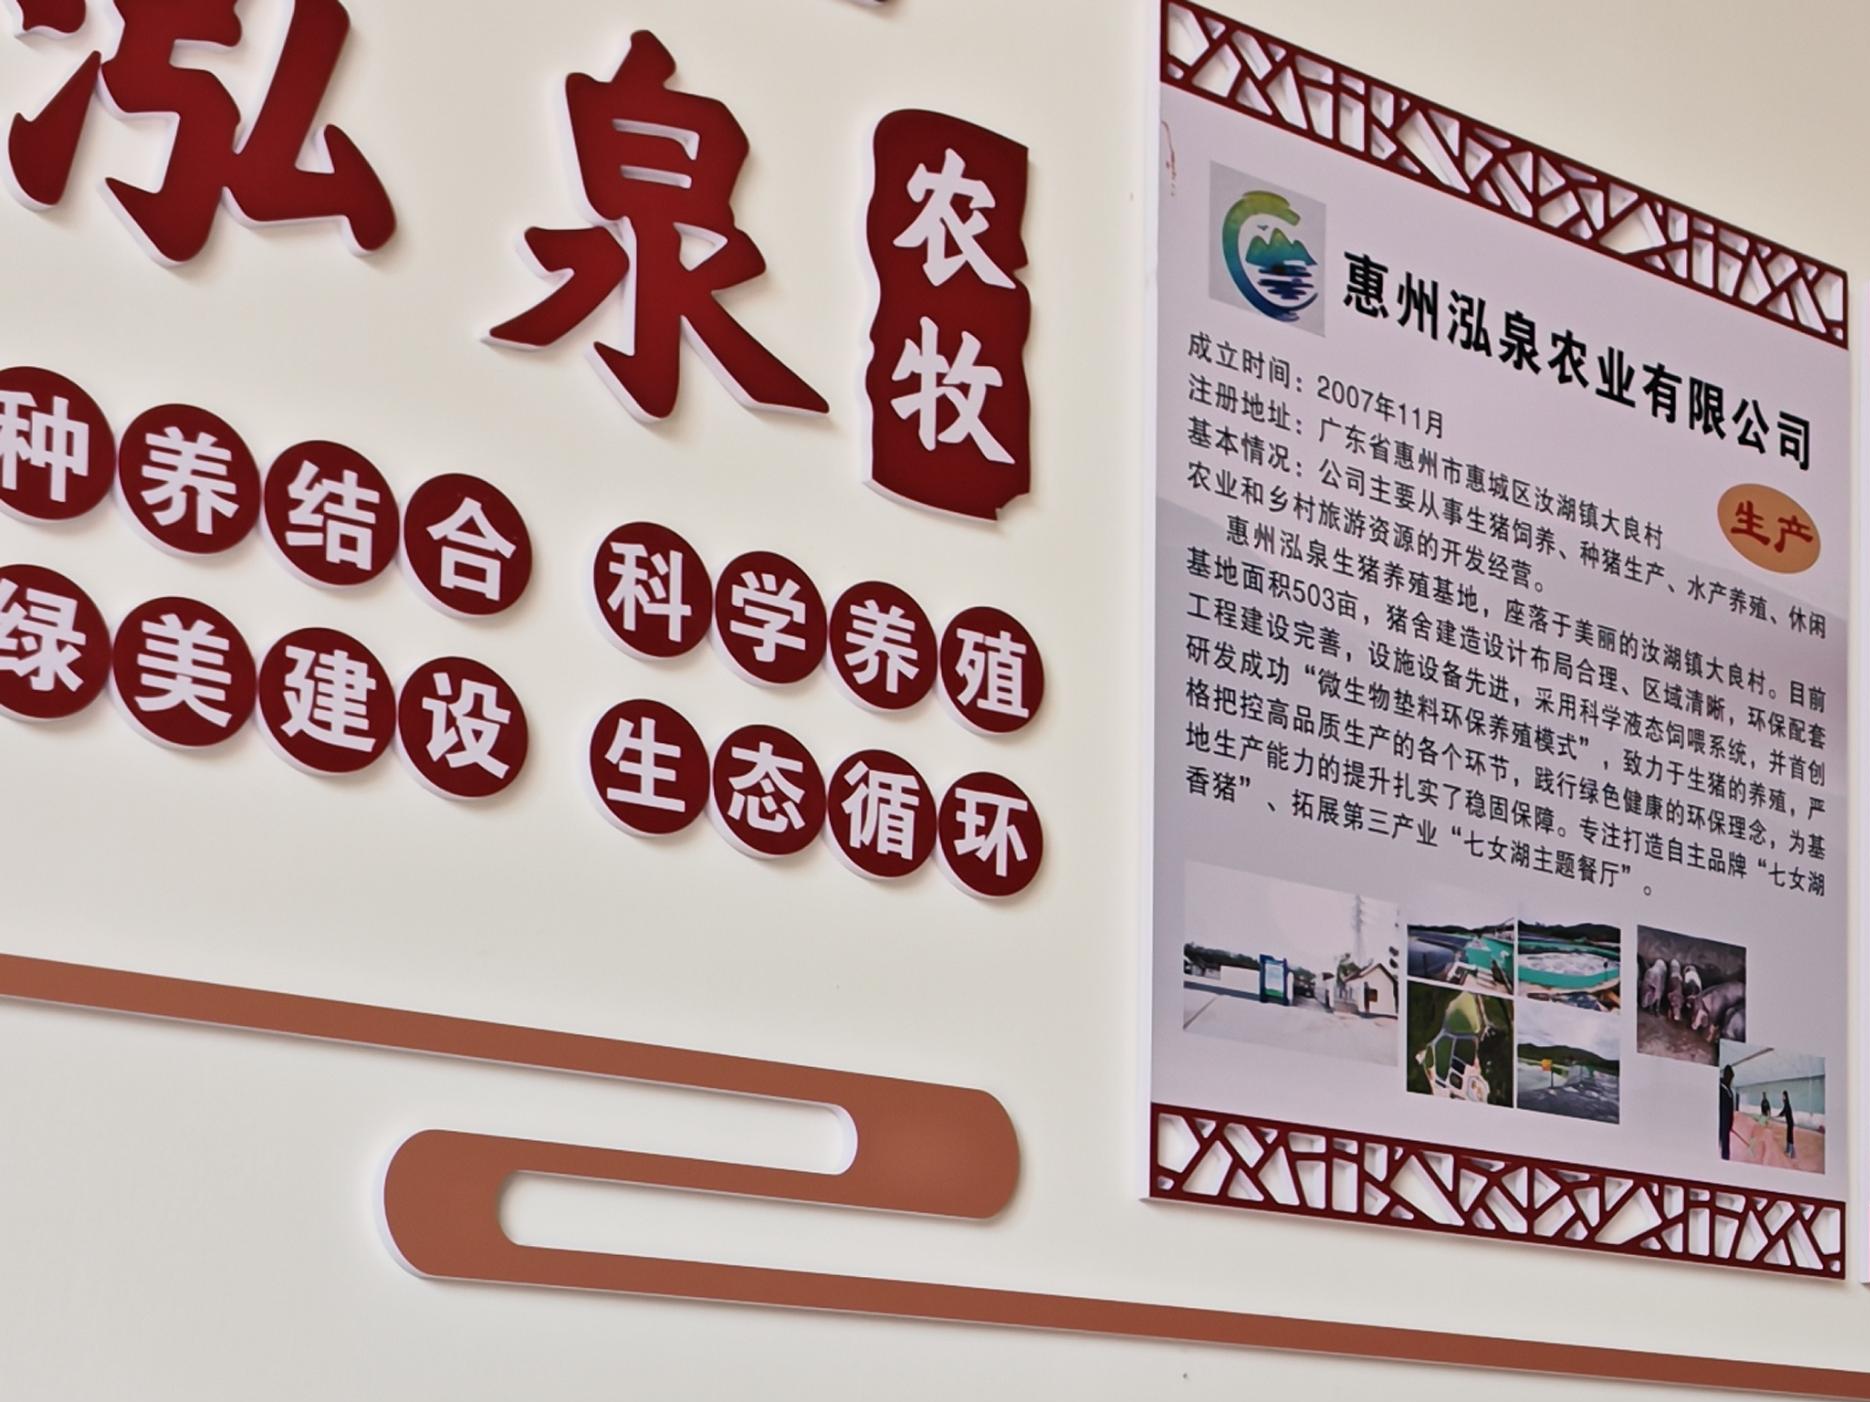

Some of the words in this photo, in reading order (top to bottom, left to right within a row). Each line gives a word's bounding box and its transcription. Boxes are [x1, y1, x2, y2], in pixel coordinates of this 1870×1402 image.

[893, 148, 1014, 464] 农牧
[1343, 250, 1812, 471] 惠州泓泉农业有限公司
[0, 391, 516, 601] 种养结合
[607, 539, 1029, 721] 科学养殖
[1731, 500, 1815, 554] 生产
[0, 577, 510, 776] 绿美建设
[605, 721, 1029, 879] 生态循环
